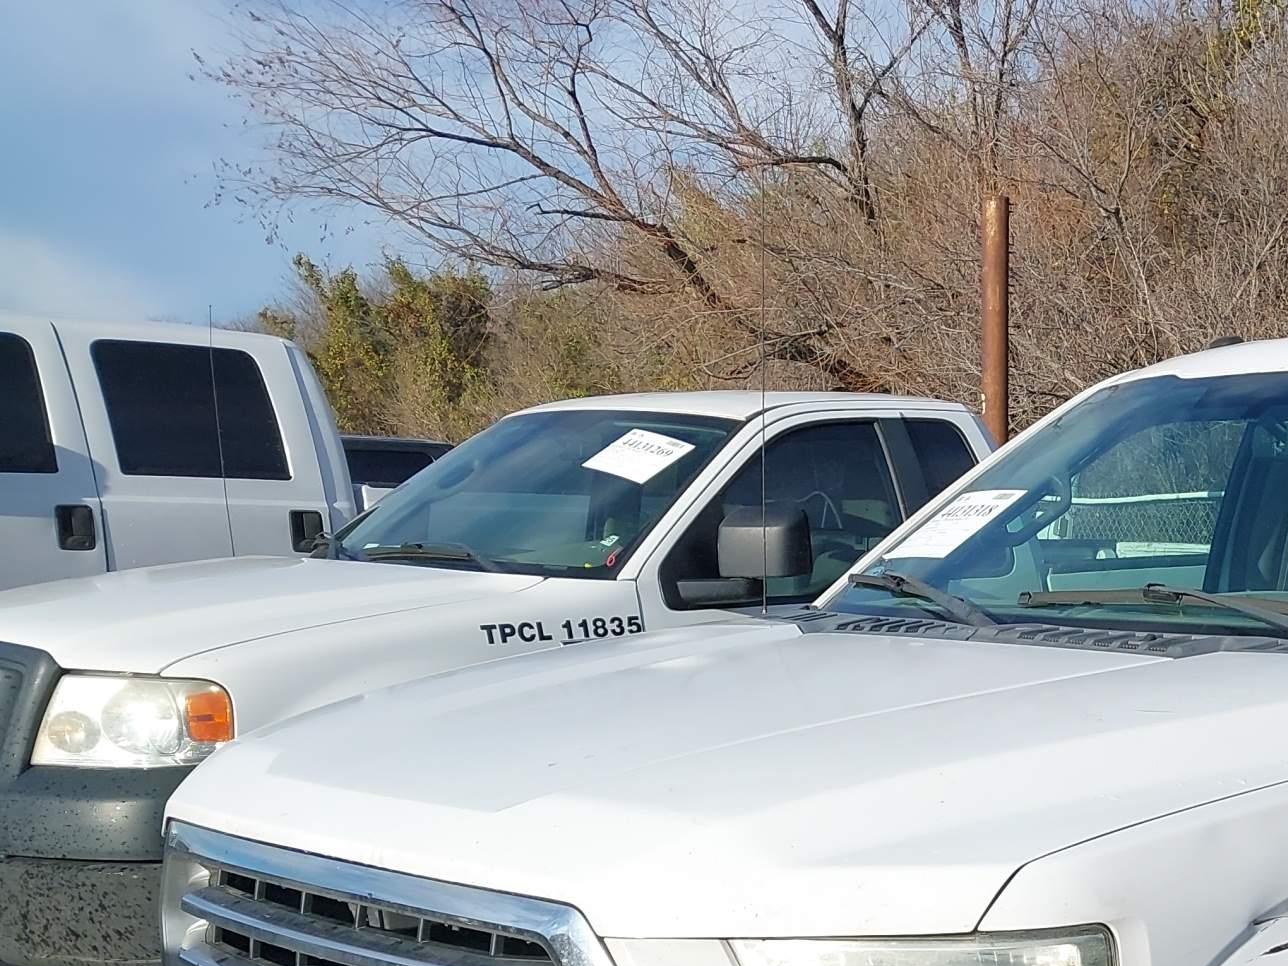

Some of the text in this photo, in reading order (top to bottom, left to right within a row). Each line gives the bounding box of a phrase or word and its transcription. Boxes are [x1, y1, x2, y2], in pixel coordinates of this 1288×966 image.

[622, 438, 674, 456] 44131269
[479, 615, 642, 645] TPCL 11835
